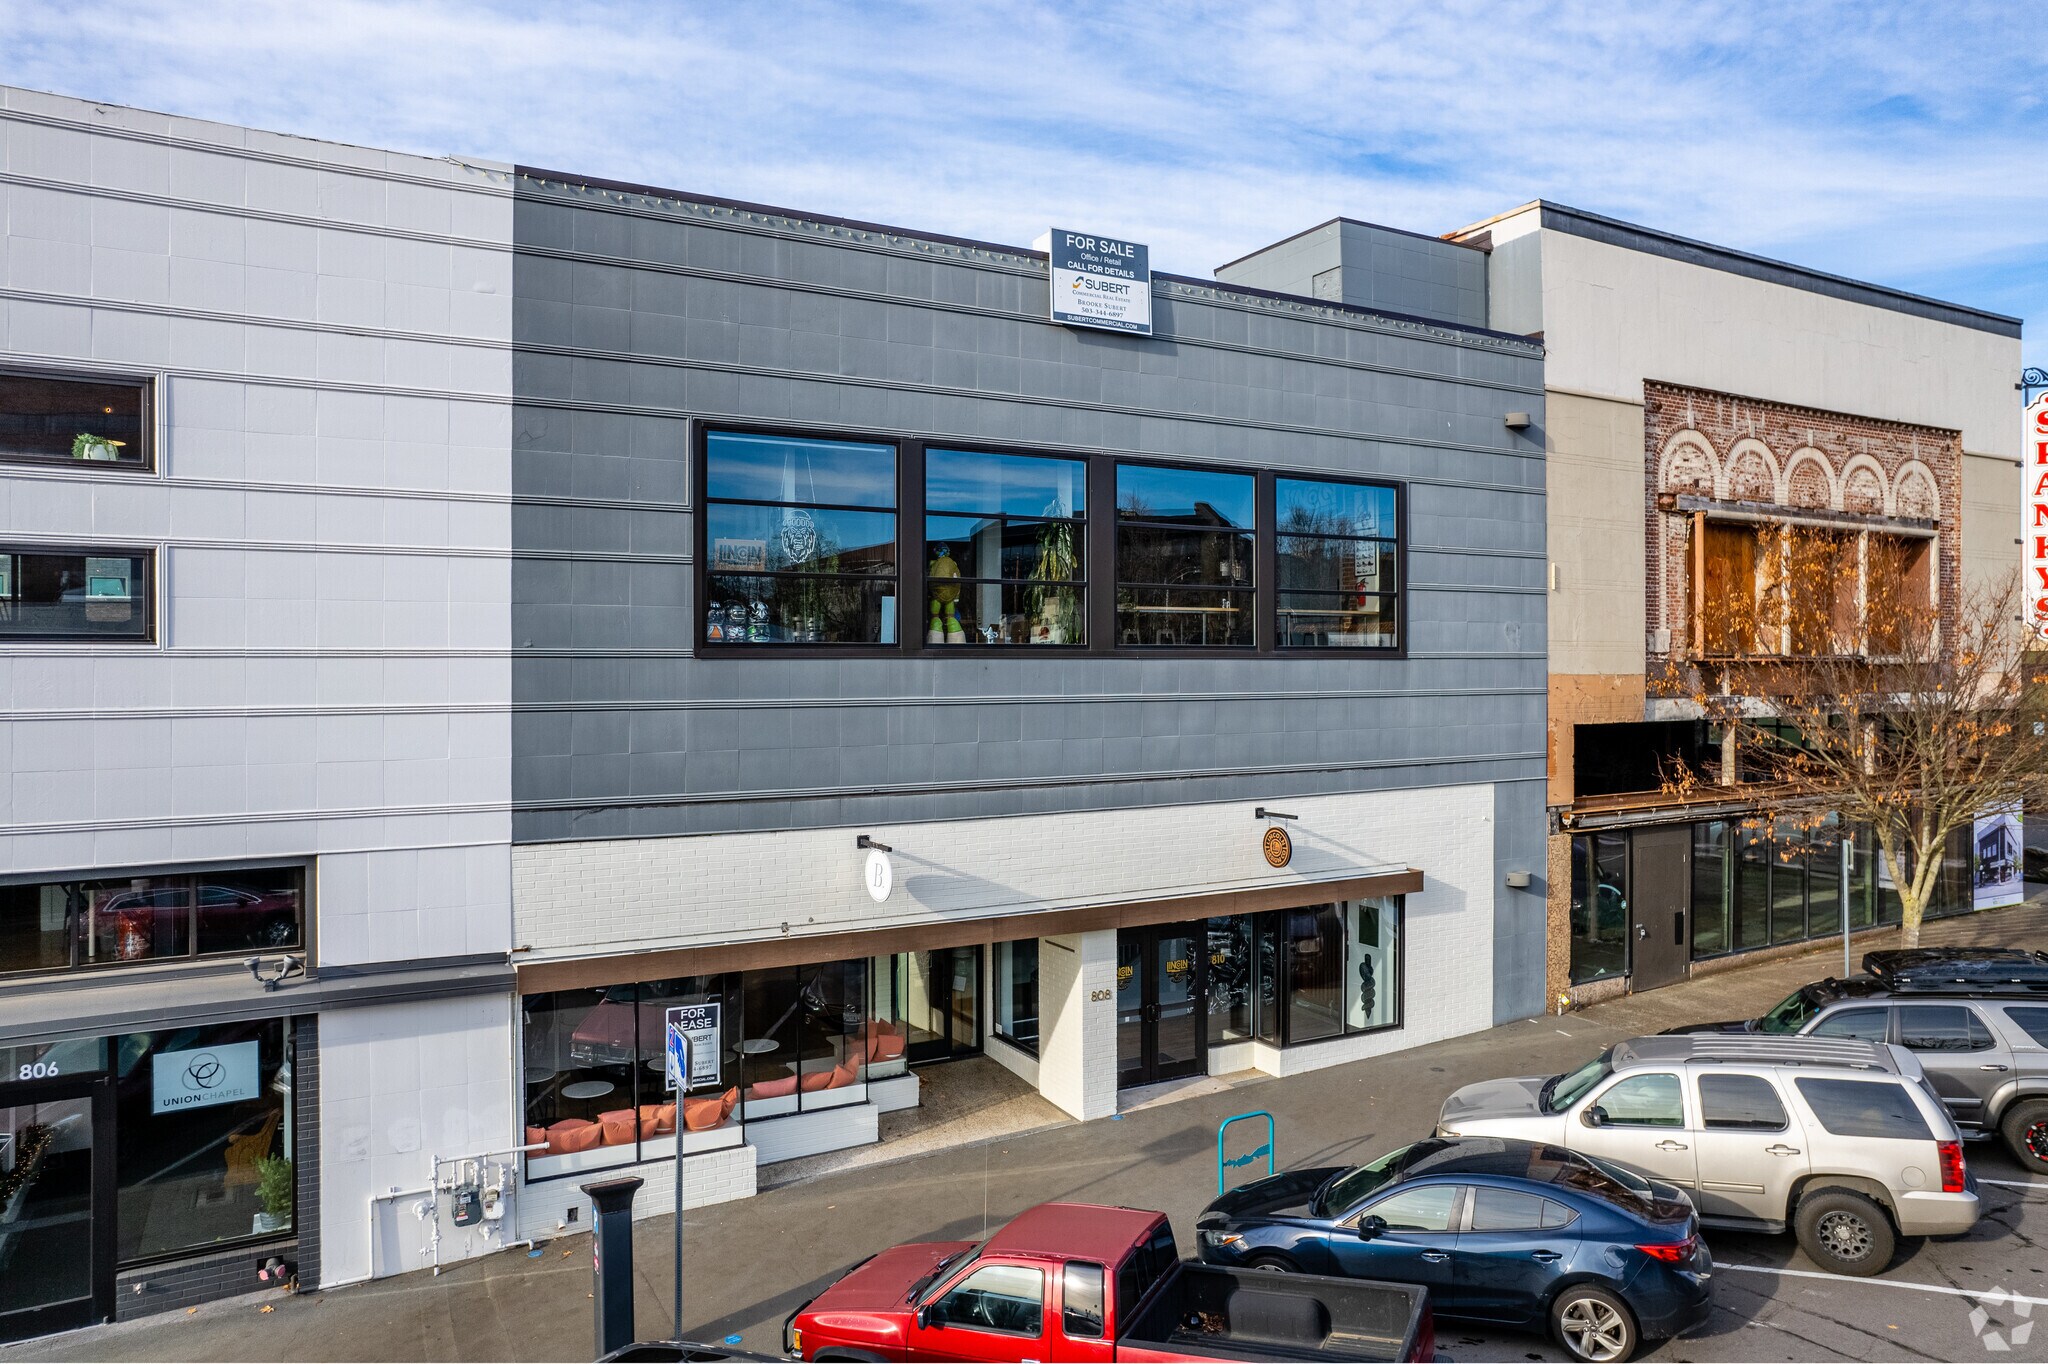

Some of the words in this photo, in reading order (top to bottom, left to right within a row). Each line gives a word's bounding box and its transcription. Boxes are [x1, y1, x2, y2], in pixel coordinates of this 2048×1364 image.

[1066, 234, 1096, 251] FOR
[1099, 240, 1135, 258] SALE
[1080, 253, 1099, 263] Office
[1103, 256, 1122, 266] Retail
[1067, 261, 1087, 271] CALL
[1087, 264, 1104, 274] FOR
[1104, 267, 1135, 278] DETAILS
[1085, 278, 1130, 295] SUBERT
[1067, 314, 1138, 330] SUBERTCOMMERCIAL.COM
[1211, 953, 1226, 965] 810
[1091, 989, 1112, 1002] 808
[680, 1008, 706, 1020] FOR
[680, 1018, 712, 1030] EASE
[692, 1034, 713, 1043] BERT
[19, 1061, 59, 1081] 806
